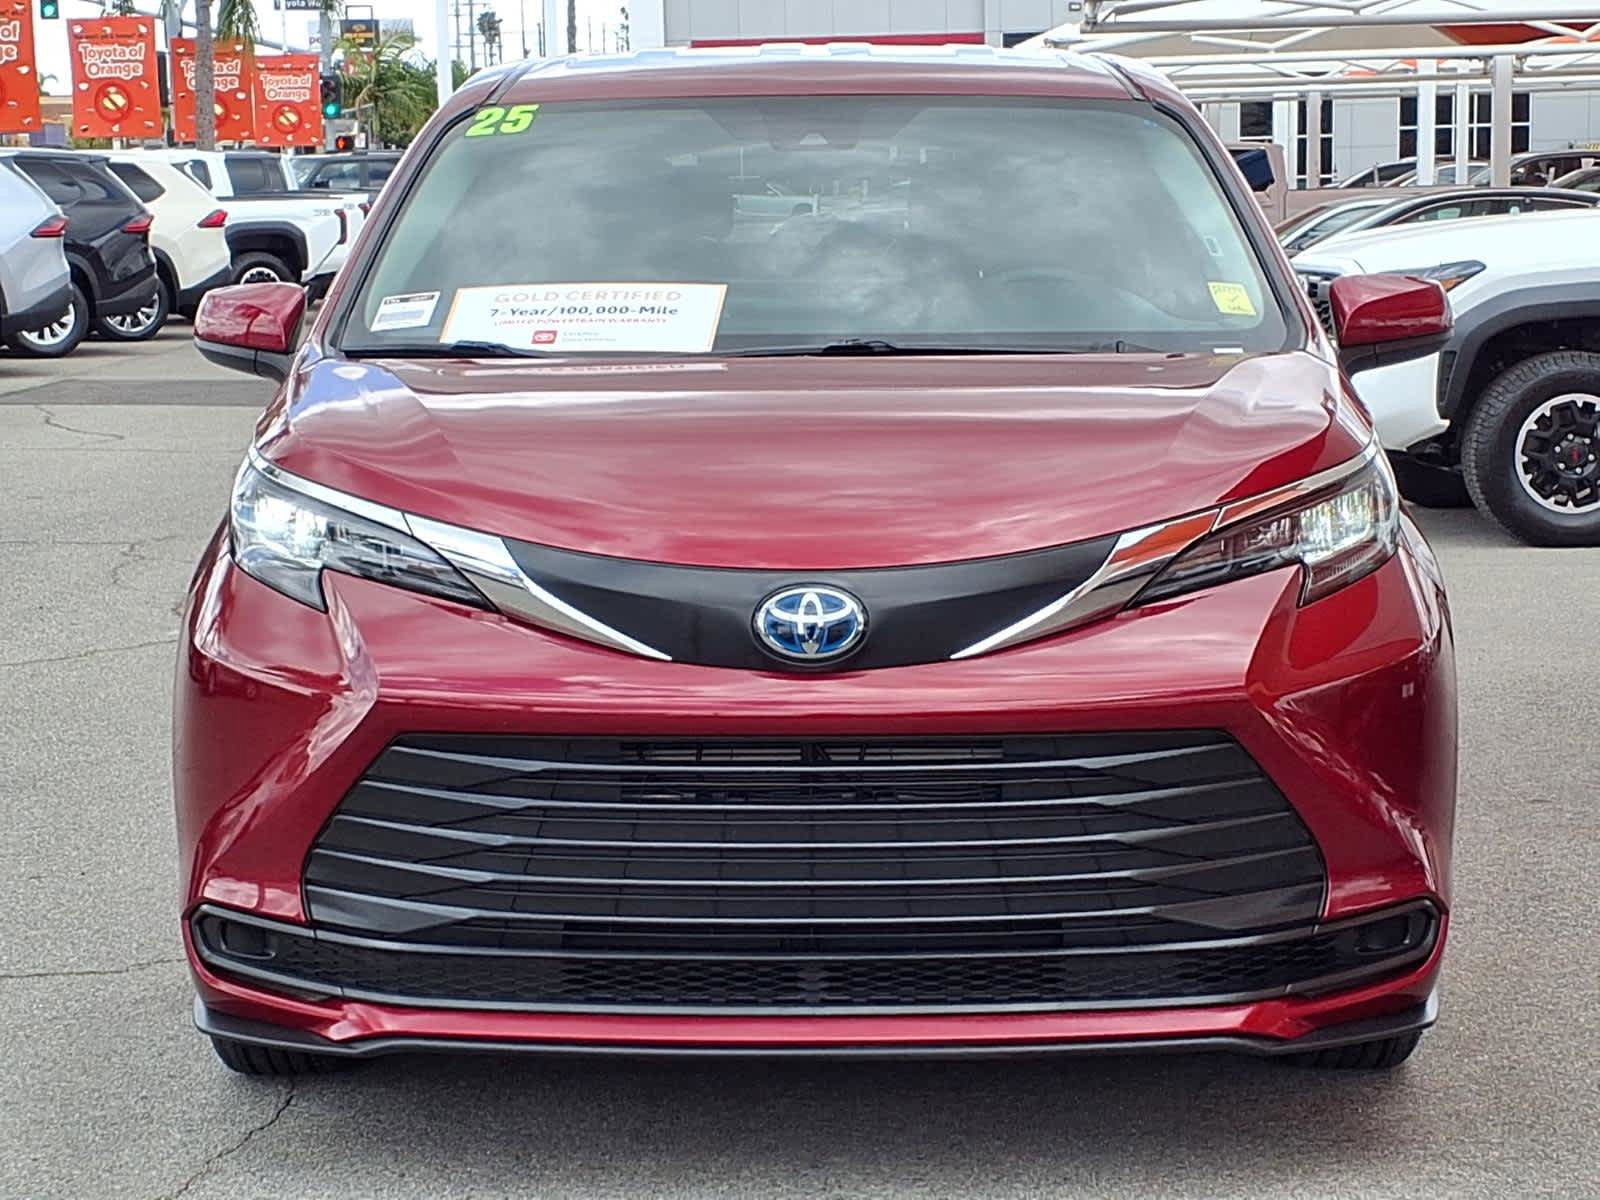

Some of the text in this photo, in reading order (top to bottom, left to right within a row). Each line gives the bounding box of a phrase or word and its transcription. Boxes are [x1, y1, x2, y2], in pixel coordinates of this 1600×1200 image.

[276, 0, 306, 9] Tyota
[1, 22, 18, 39] of
[80, 43, 144, 61] Toyota of
[87, 62, 141, 77] Orange
[225, 60, 239, 73] of
[261, 74, 310, 88] Toyota of
[266, 87, 309, 100] Orange
[464, 103, 540, 137] 25
[494, 288, 682, 303] GOLD CERTIFIED
[489, 304, 679, 318] 7-Year/100,000-Mile
